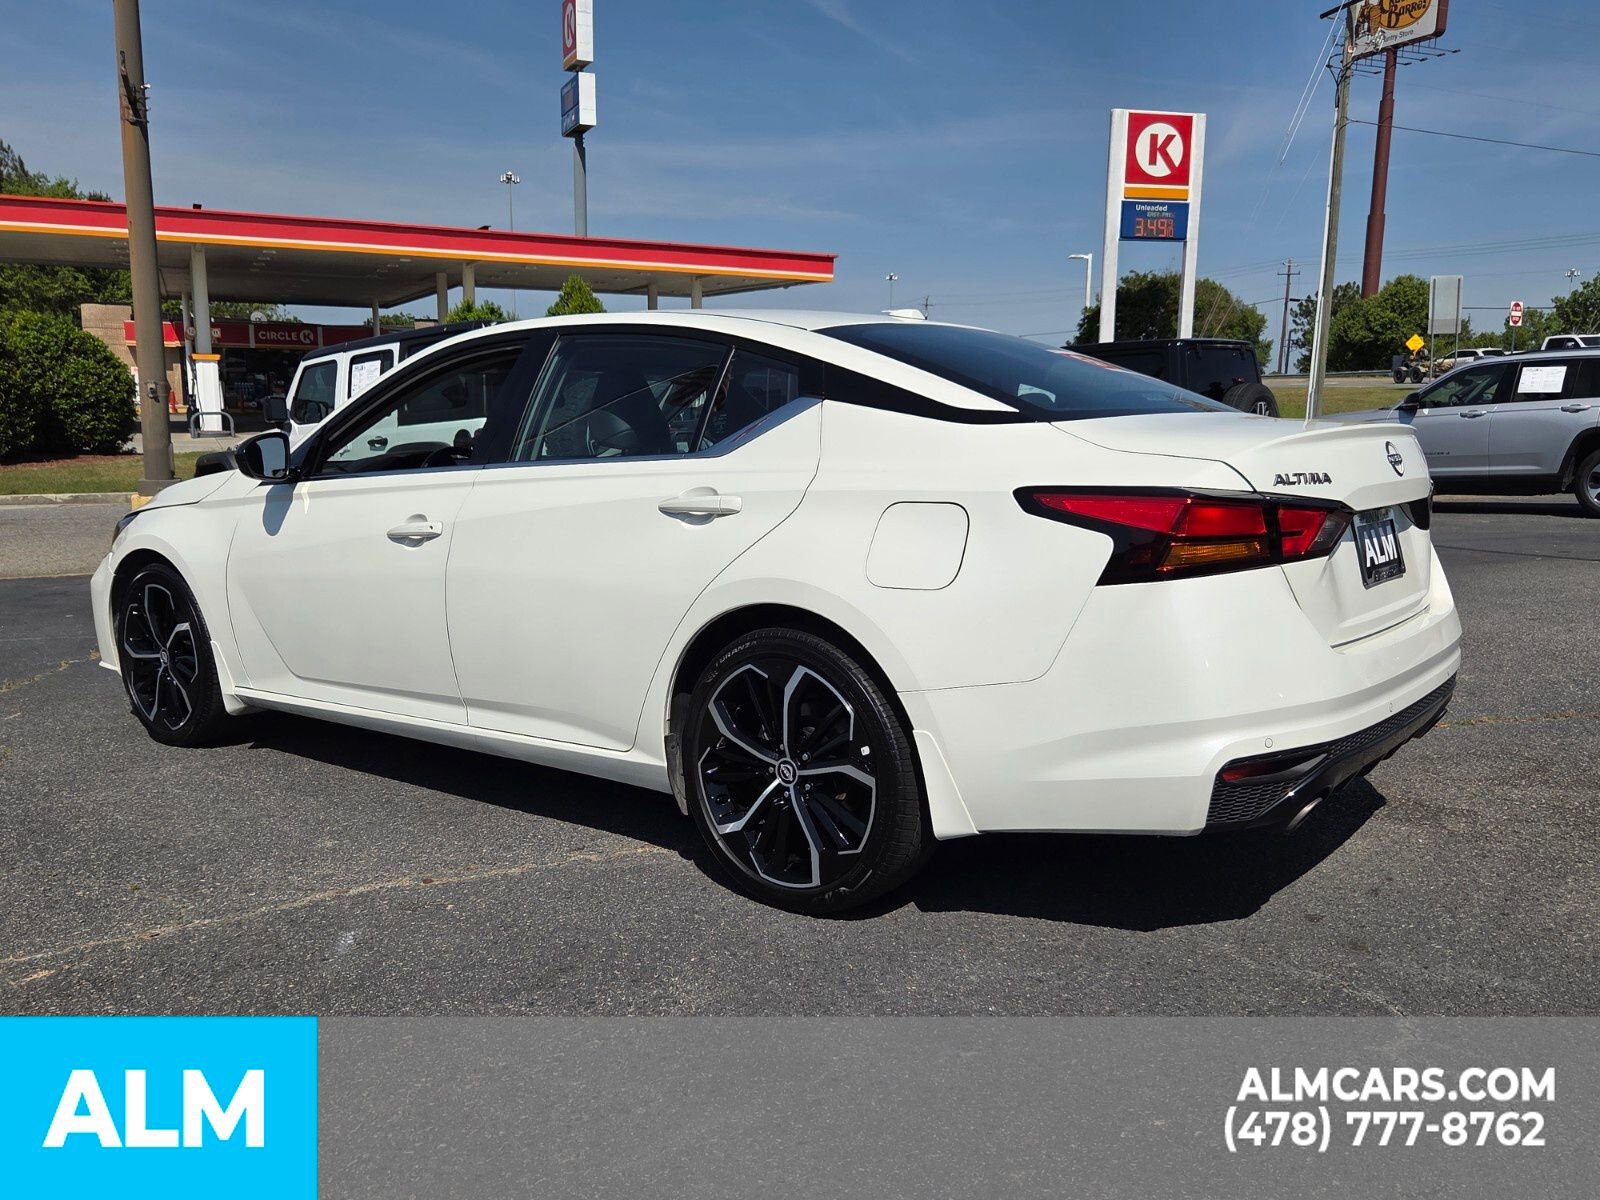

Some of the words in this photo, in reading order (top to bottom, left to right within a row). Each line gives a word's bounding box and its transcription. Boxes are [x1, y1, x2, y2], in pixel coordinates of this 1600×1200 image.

[1148, 133, 1177, 174] K
[1135, 204, 1168, 212] Unleaded
[258, 331, 299, 341] CIRCLE
[300, 330, 314, 344] K
[1273, 472, 1332, 487] ALTIMA
[1363, 525, 1398, 568] ALM
